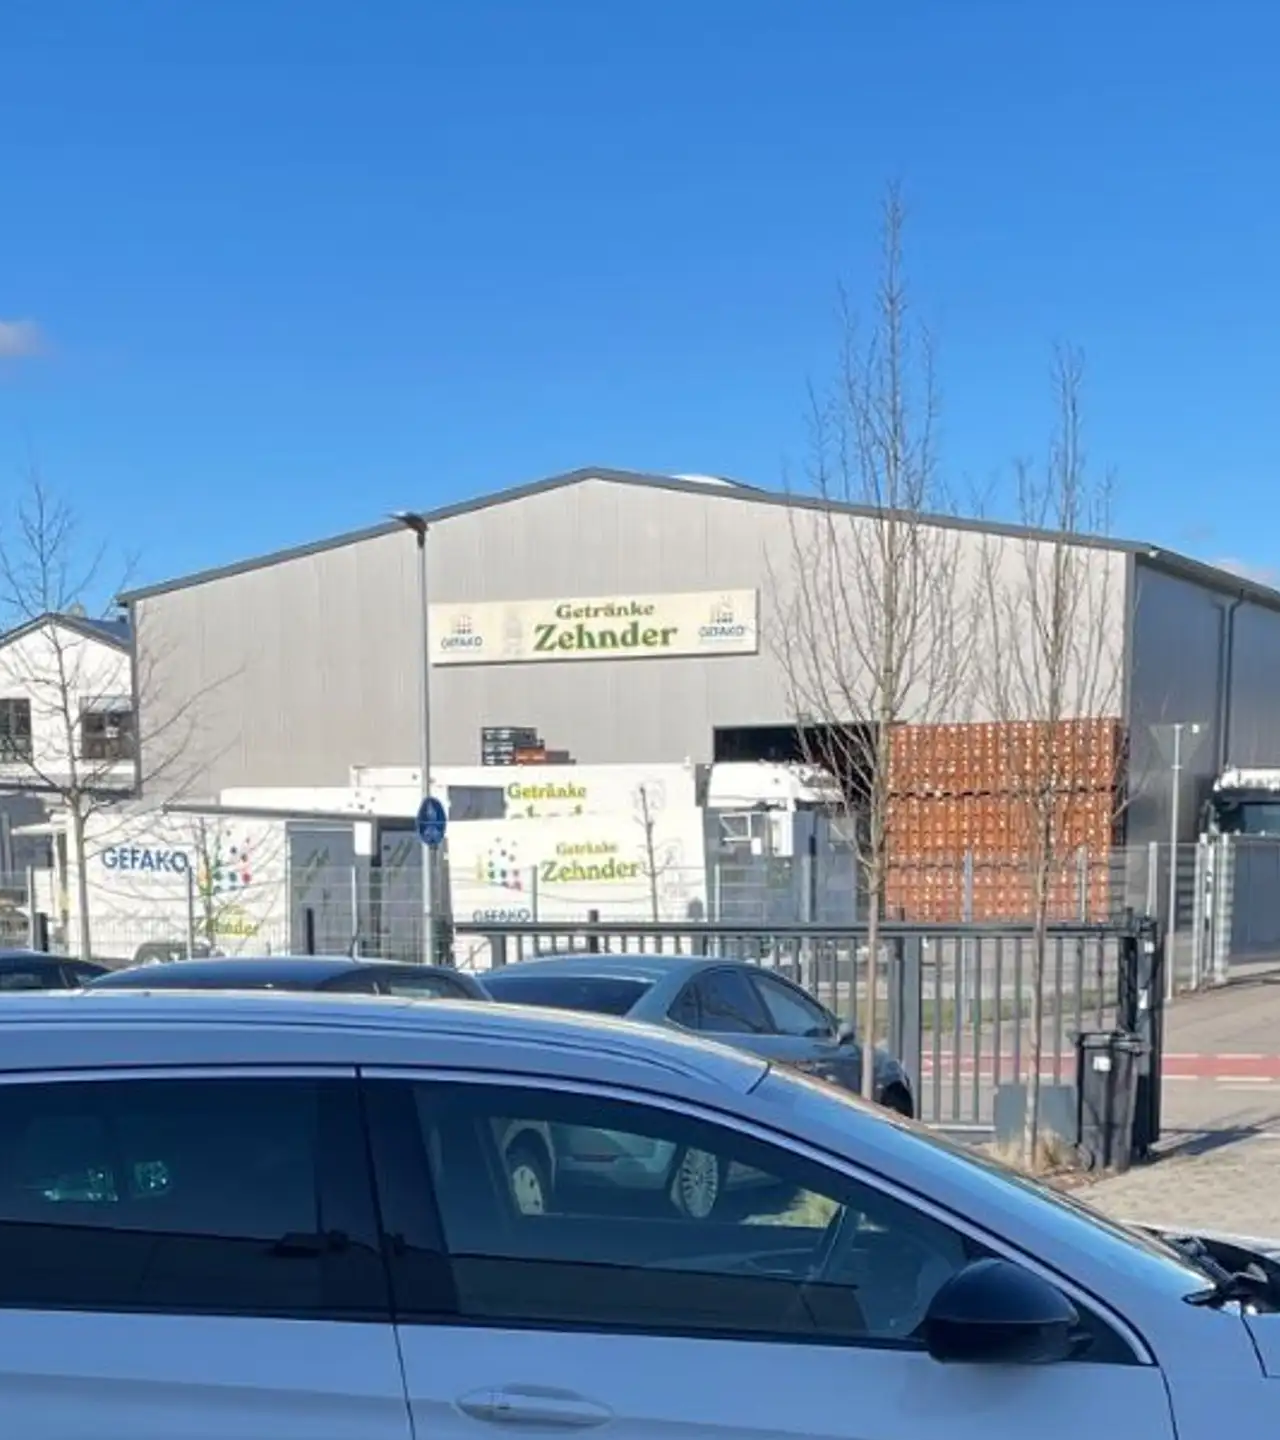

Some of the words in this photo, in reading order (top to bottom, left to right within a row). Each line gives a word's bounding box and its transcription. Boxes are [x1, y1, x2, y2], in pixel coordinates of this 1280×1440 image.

[556, 601, 654, 619] Getränke
[533, 621, 678, 651] Zehnder
[507, 781, 586, 799] Getränke
[102, 847, 189, 873] GEFAKO
[541, 858, 638, 882] Zehnder
